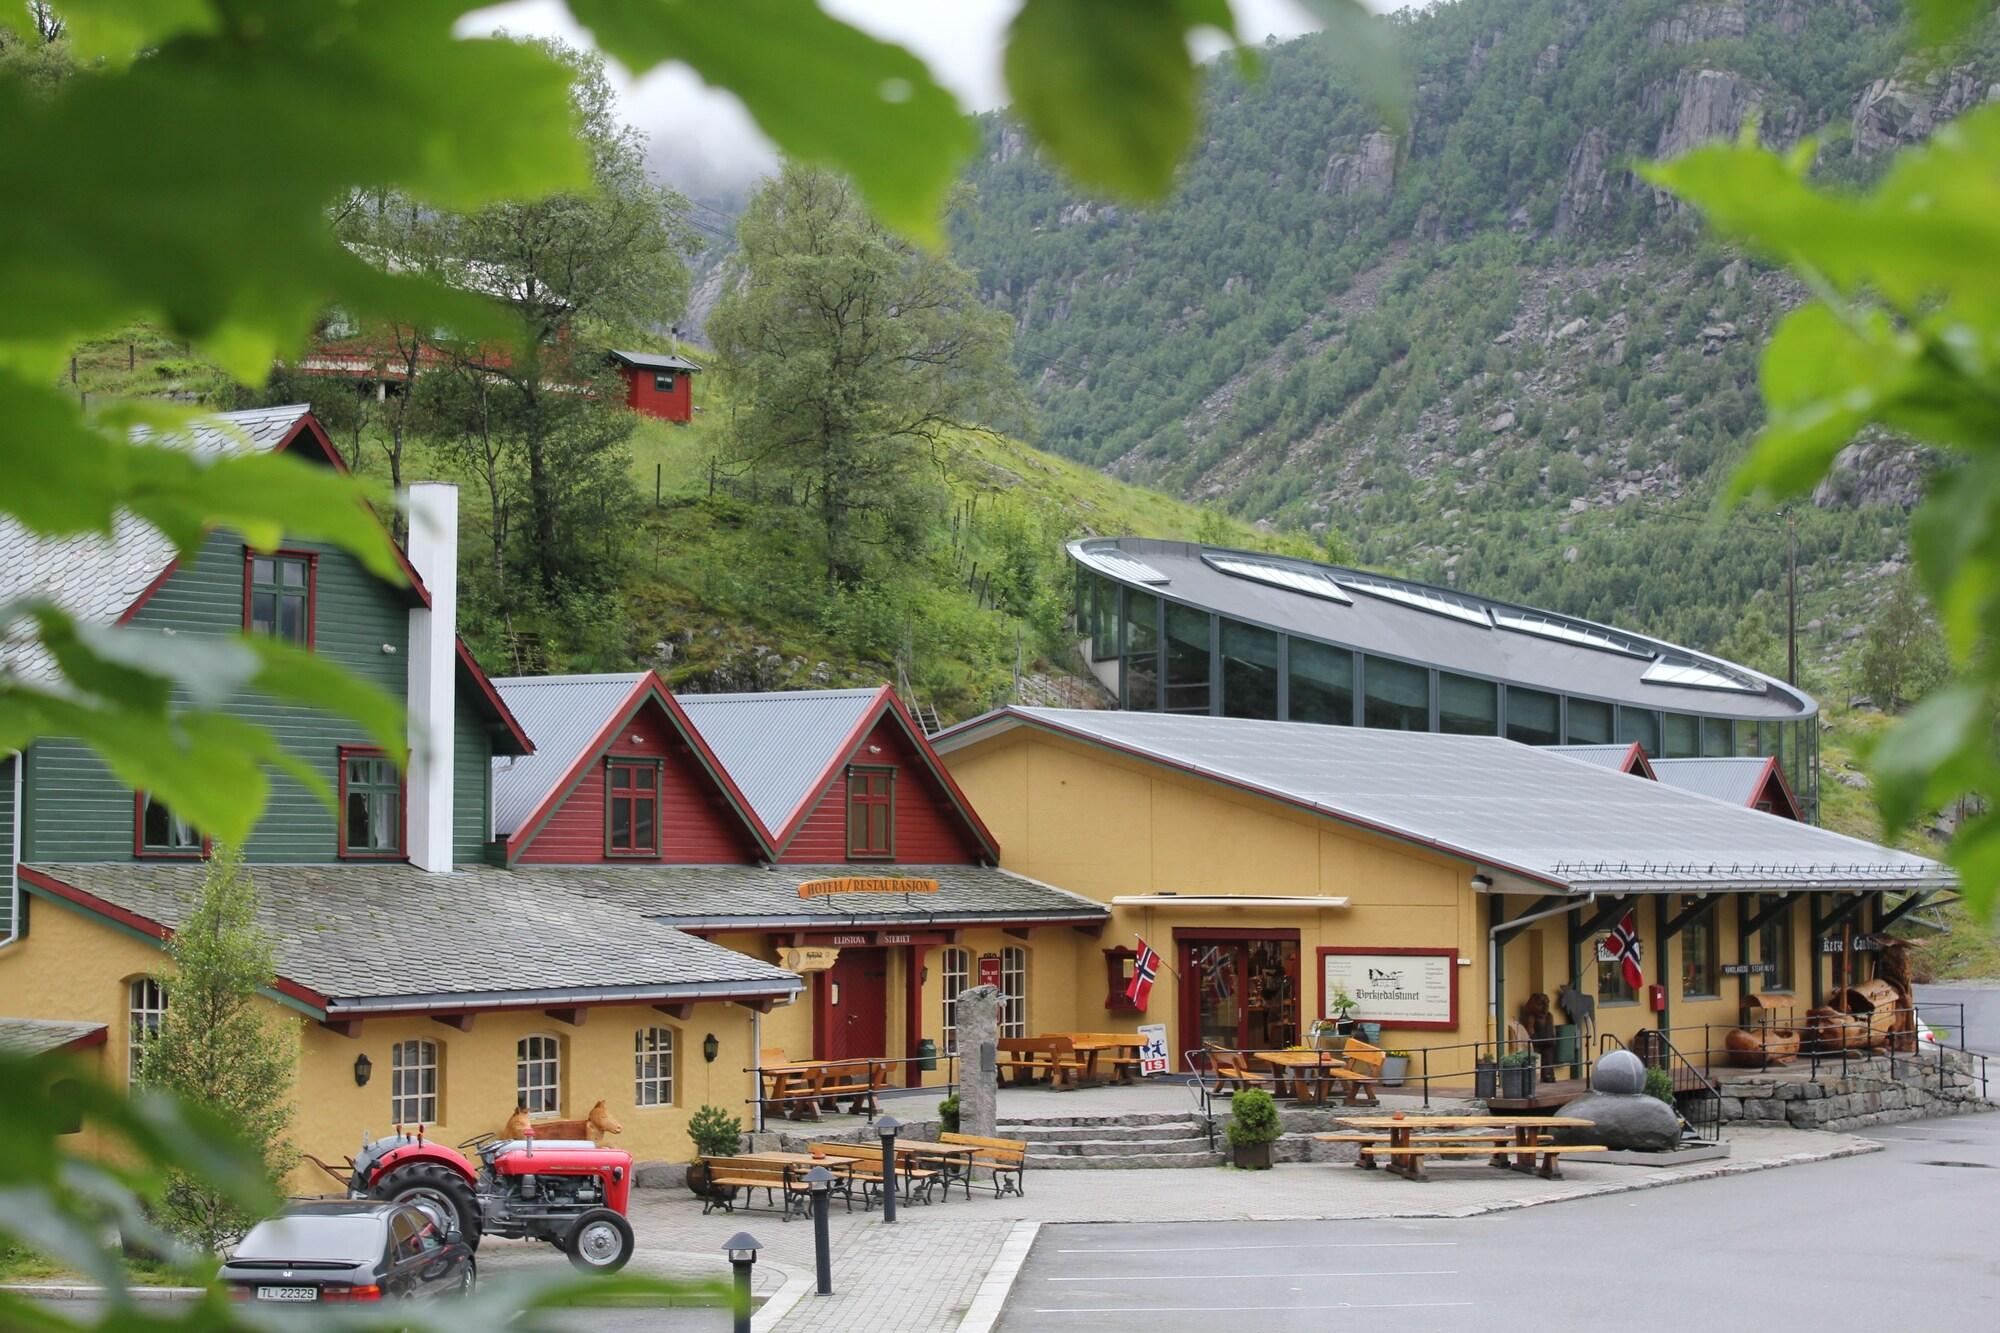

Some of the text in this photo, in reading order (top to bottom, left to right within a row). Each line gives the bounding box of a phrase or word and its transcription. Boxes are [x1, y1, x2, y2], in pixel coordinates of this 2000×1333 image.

[833, 936, 866, 945] ELDSTOVA
[884, 935, 910, 943] STERIET
[1148, 1060, 1163, 1070] IS
[262, 1288, 313, 1298] TL 22329
